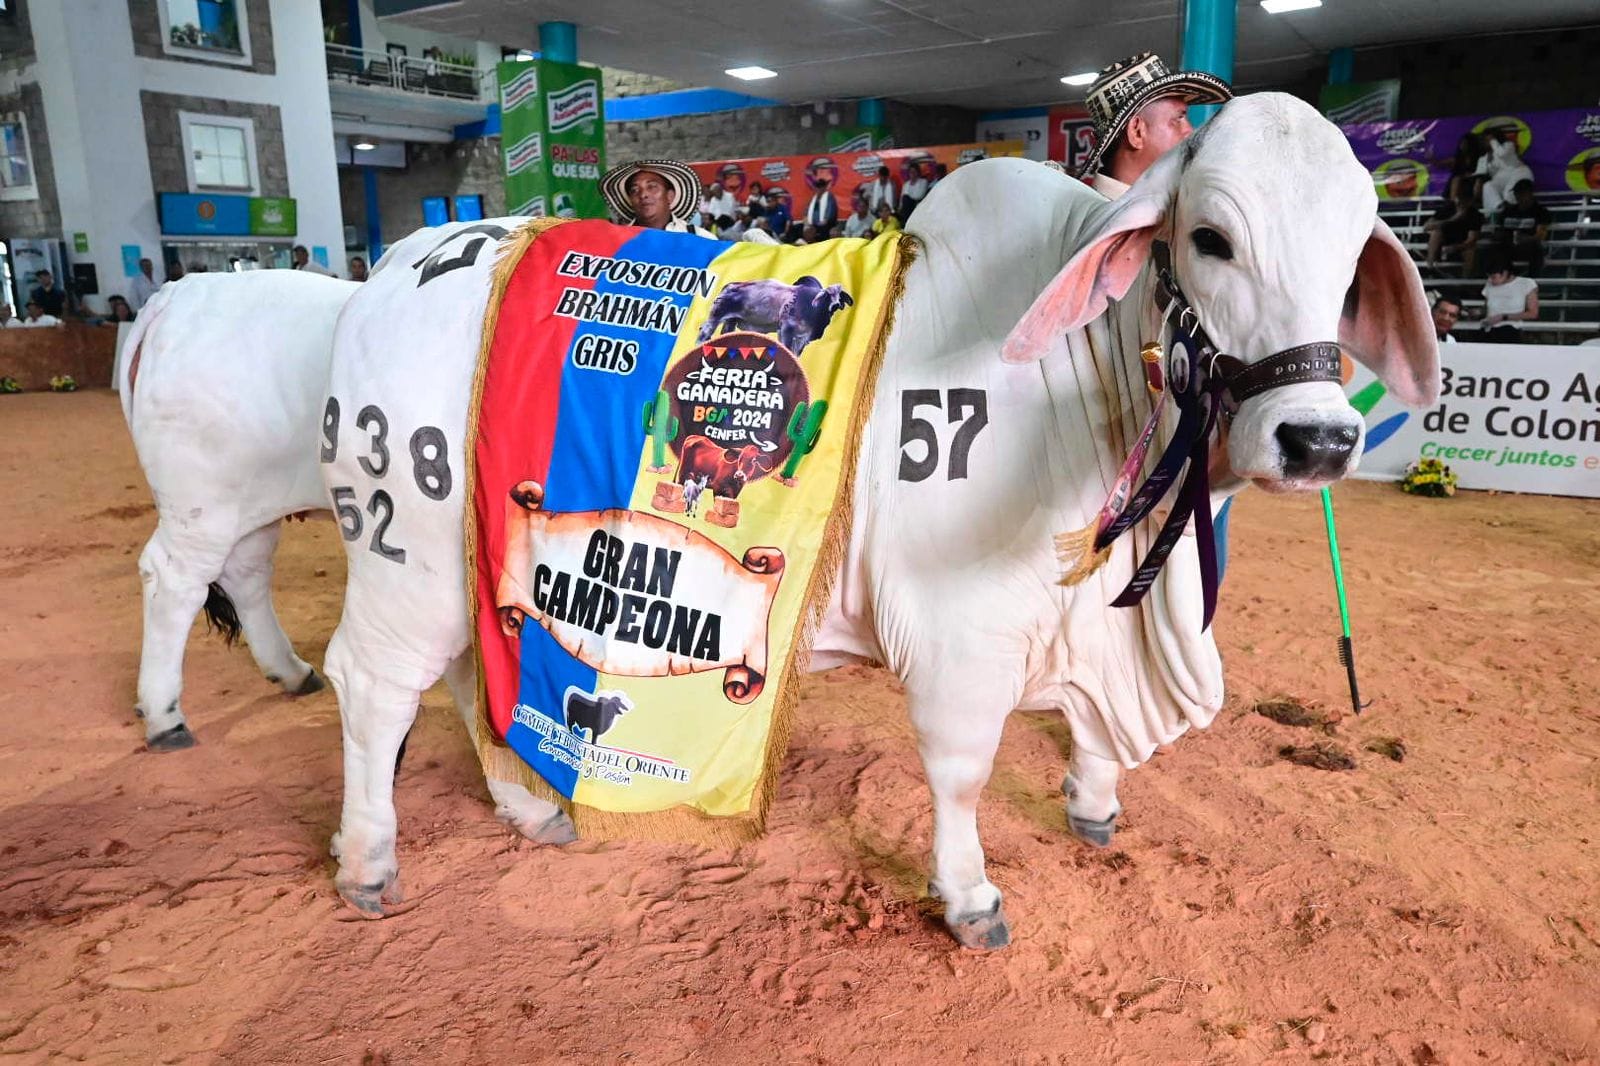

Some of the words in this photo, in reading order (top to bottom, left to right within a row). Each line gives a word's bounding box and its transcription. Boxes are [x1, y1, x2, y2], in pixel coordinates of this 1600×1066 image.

[558, 252, 715, 298] EXPOSICION
[556, 289, 687, 334] BRAHMÁN
[574, 335, 638, 374] GRIS
[677, 382, 784, 410] GANADERA
[698, 366, 768, 389] FERIA
[1562, 372, 1600, 412] A
[704, 425, 747, 441] CENFER
[732, 408, 772, 429] 2024
[898, 387, 989, 483] 57
[1423, 404, 1469, 434] de
[320, 396, 452, 501] 938
[1420, 441, 1496, 463] Crecer
[1497, 445, 1577, 468] juntos
[330, 486, 406, 565] 52
[582, 529, 682, 599] GRAN
[533, 563, 722, 662] CAMPEONA
[625, 756, 690, 782] ORIENTE
